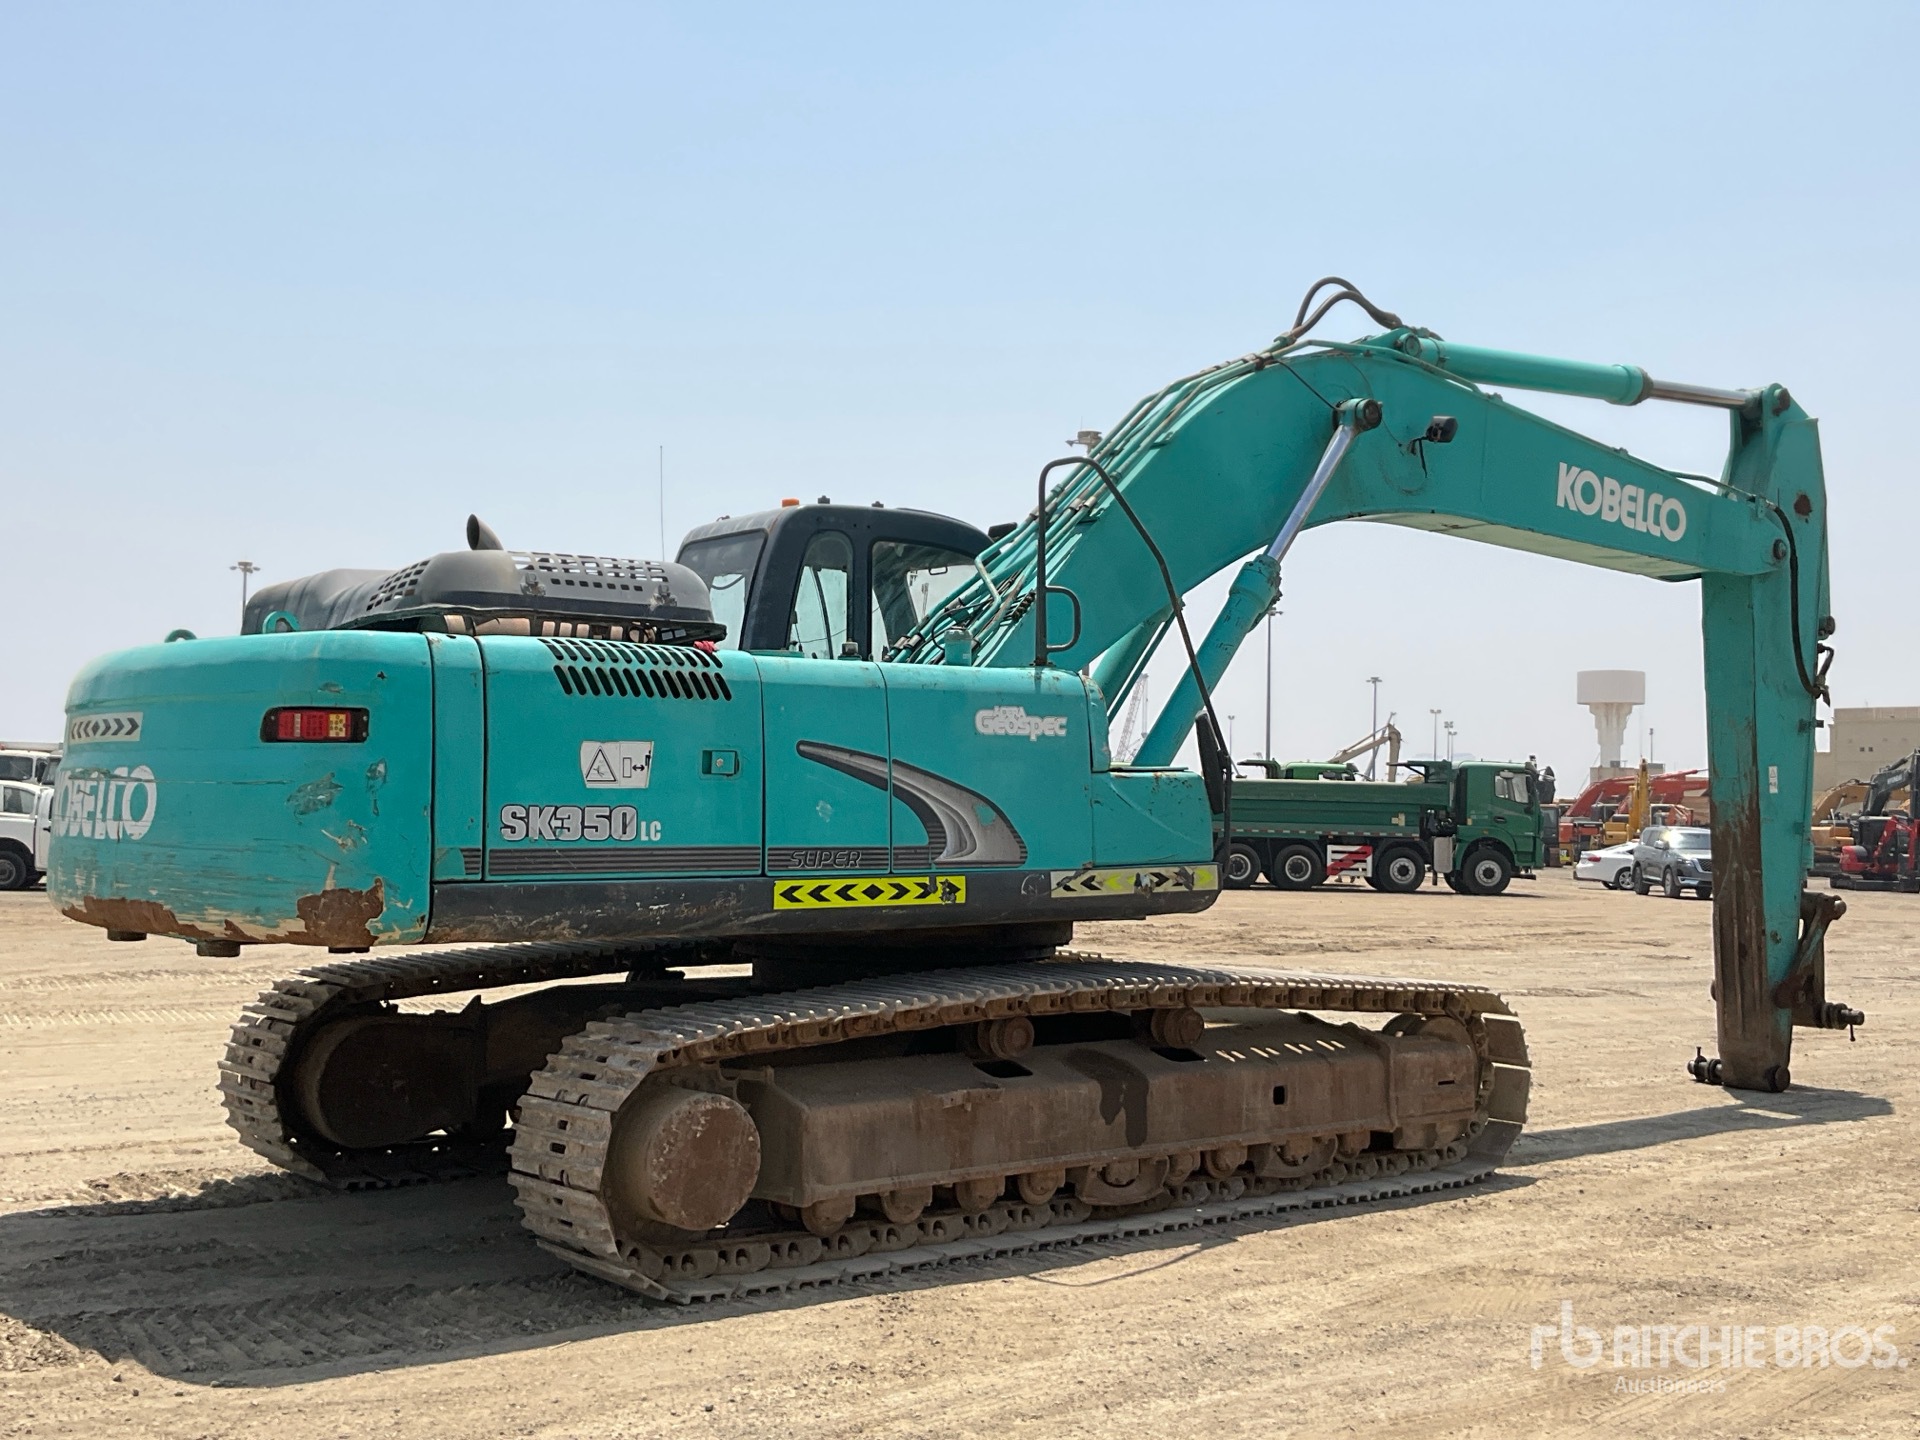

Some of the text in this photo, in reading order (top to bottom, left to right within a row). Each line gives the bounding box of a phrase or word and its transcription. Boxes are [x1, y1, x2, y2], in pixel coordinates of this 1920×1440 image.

[1556, 461, 1687, 542] KOBELCO
[501, 803, 662, 842] SK350 LC
[787, 850, 862, 869] SUPER
